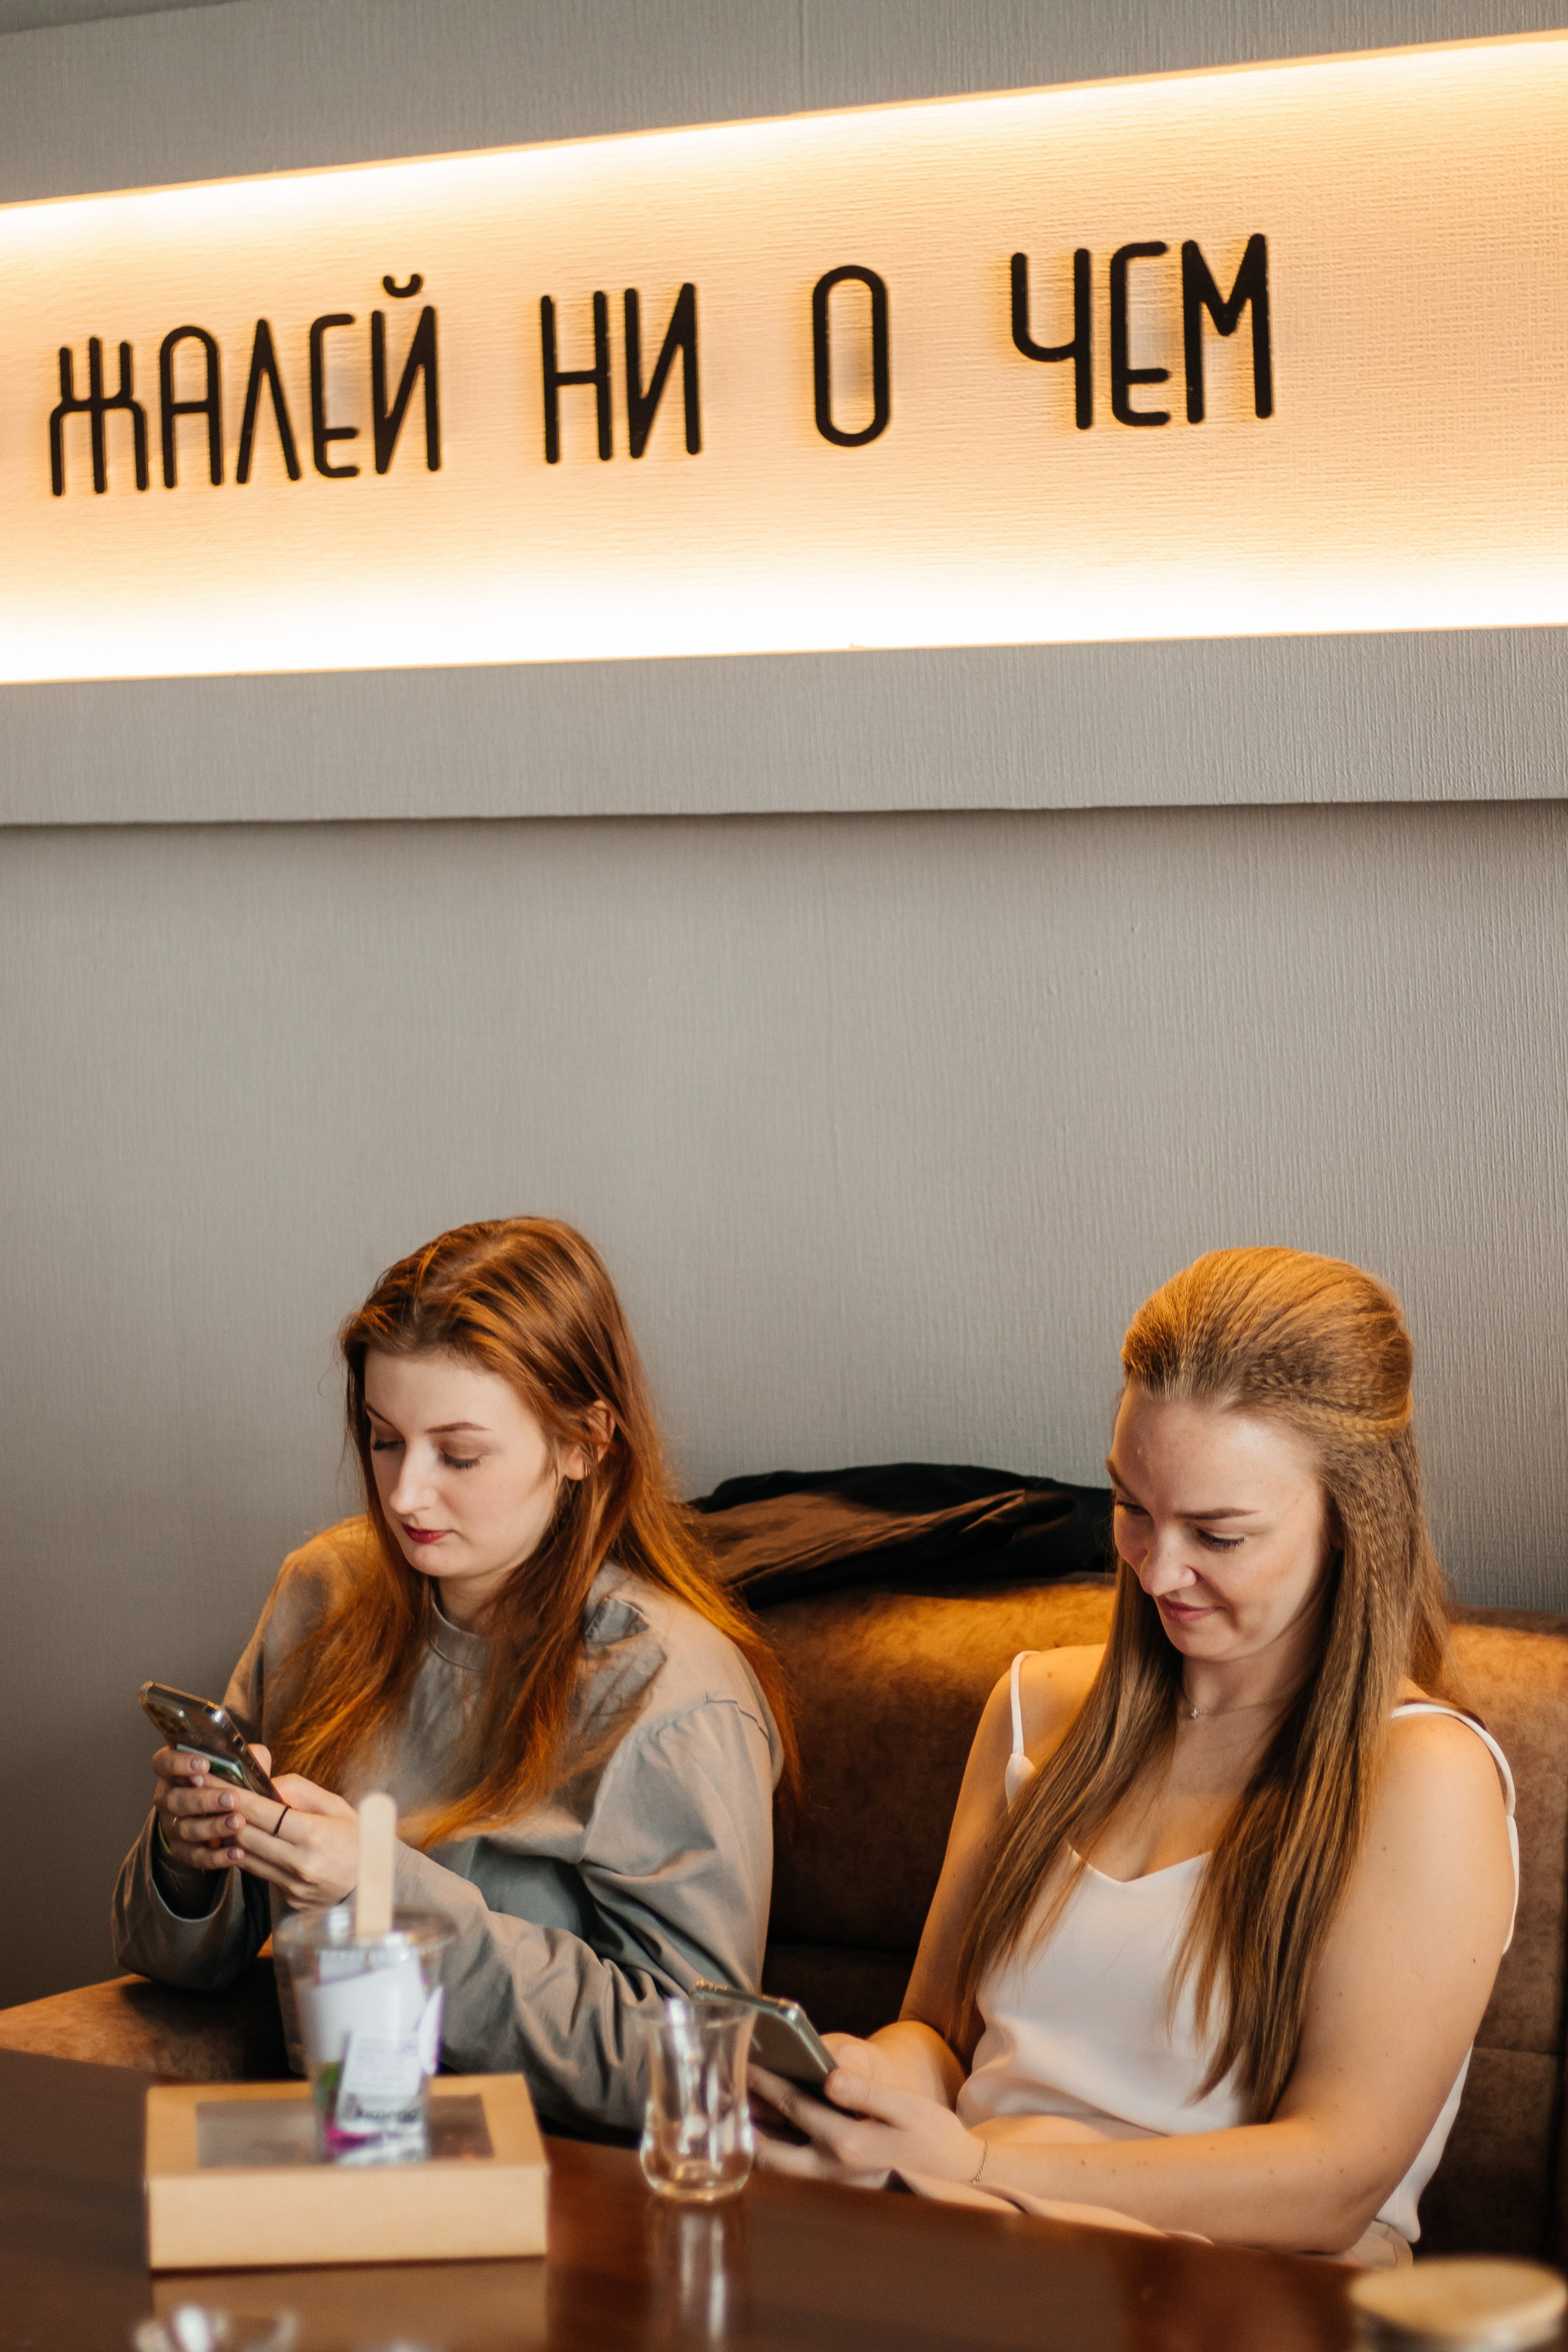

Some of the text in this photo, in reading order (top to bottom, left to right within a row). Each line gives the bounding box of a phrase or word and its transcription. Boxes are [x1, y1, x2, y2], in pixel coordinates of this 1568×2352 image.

[49, 233, 1274, 497] ЖАЛЕЙ НИ О ЧЕМ
